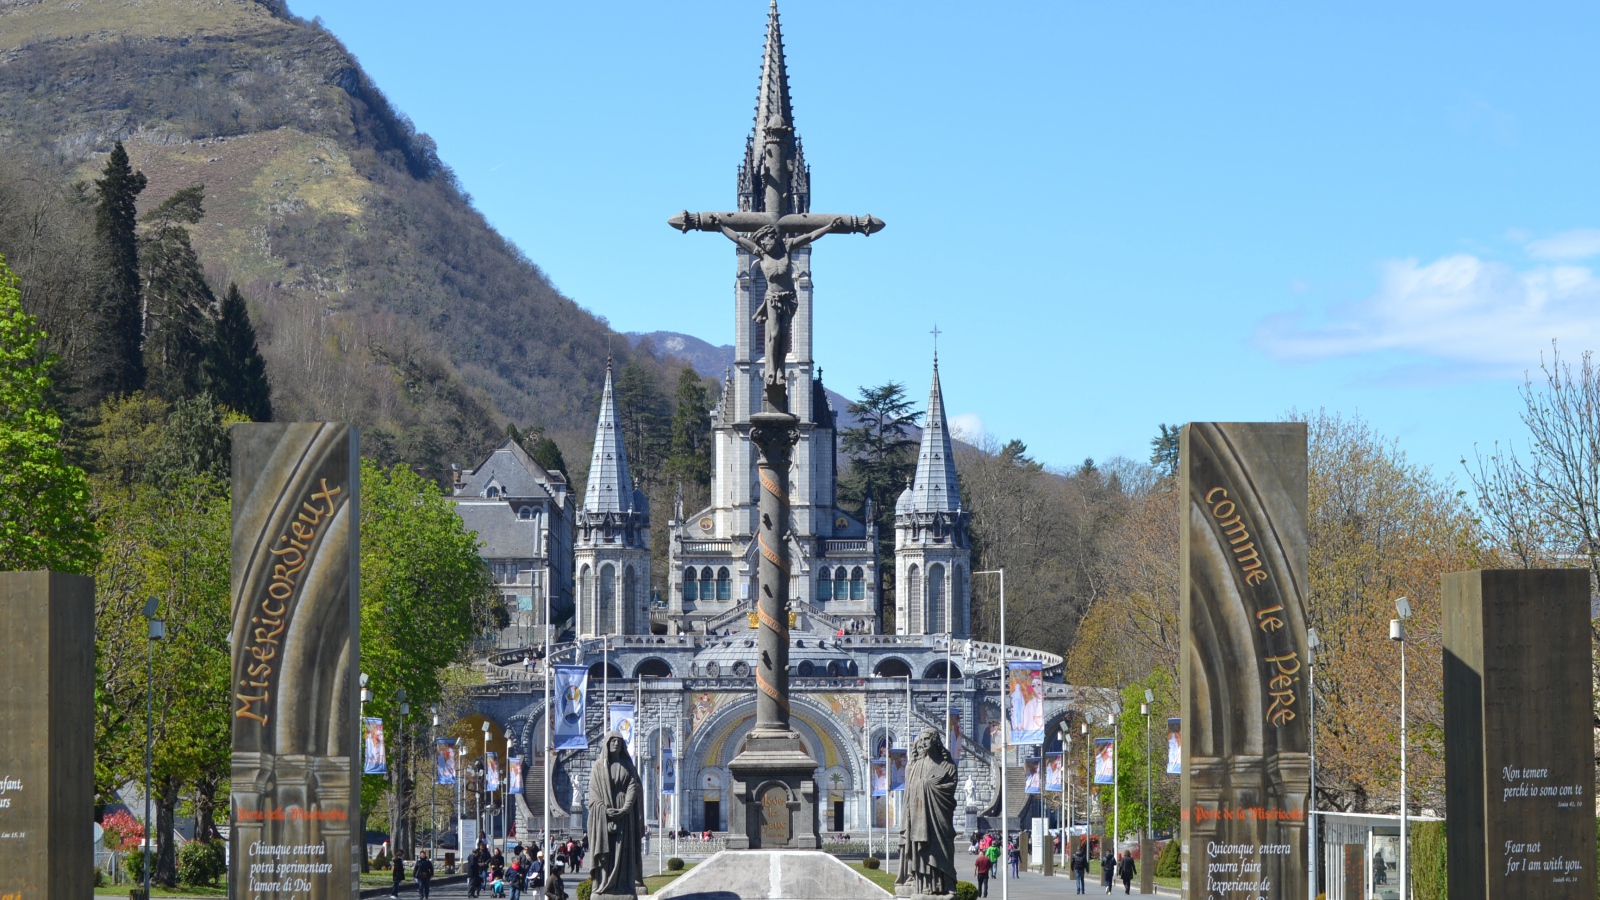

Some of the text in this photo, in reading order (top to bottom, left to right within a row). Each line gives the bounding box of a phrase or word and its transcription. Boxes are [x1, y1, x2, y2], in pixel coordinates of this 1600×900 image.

[1256, 604, 1285, 633] le
[1502, 765, 1548, 782] Non temere
[1503, 782, 1583, 802] perché io sono con te
[249, 840, 325, 859] Chiunque entrerà
[1207, 841, 1291, 858] Quiconque entrera
[1504, 840, 1541, 855] Fear not
[249, 861, 333, 878] potrà sperimentare
[1208, 858, 1261, 880] pourra faire
[1505, 856, 1582, 876] for I am with you.
[282, 877, 293, 892] di
[294, 878, 312, 892] Dio
[1260, 876, 1271, 891] de
